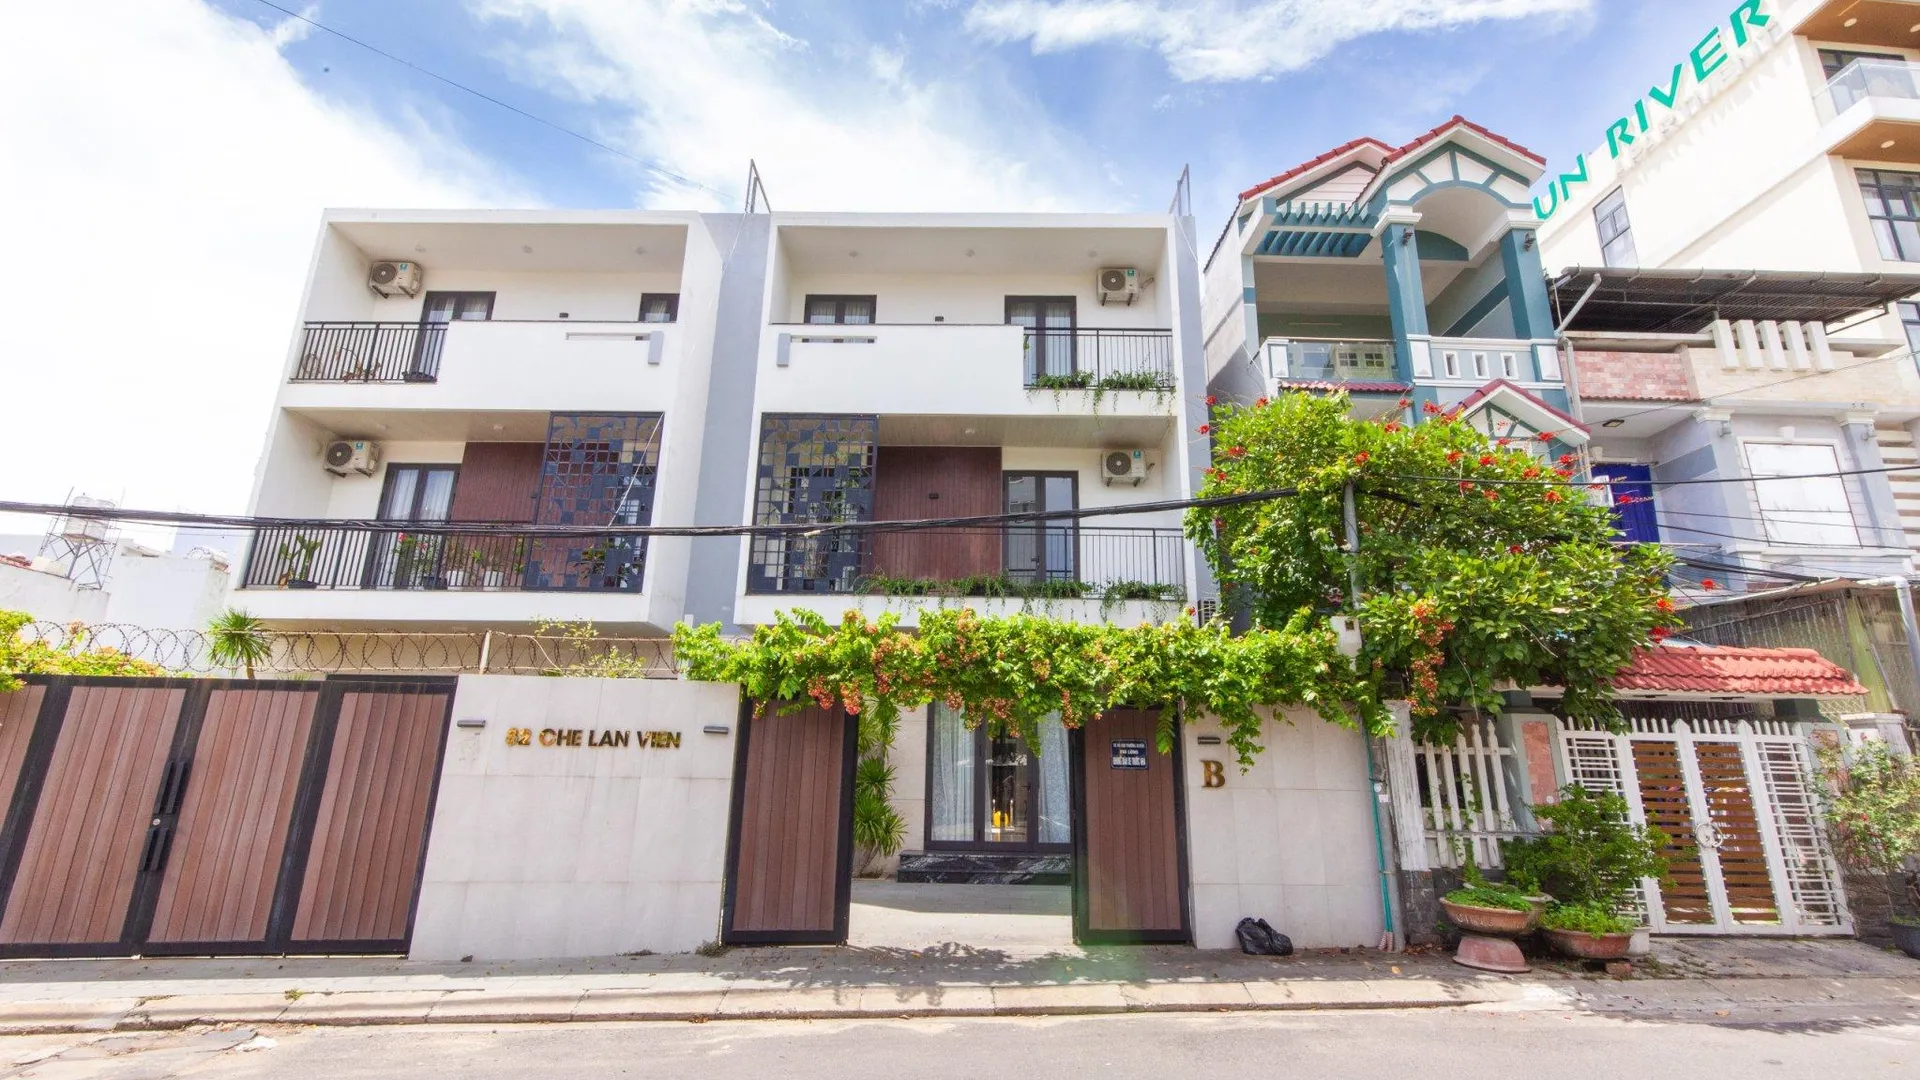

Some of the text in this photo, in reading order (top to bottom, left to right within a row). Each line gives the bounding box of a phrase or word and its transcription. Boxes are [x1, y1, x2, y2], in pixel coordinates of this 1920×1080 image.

[1605, 0, 1771, 159] RIVER
[538, 728, 583, 748] CHE
[588, 730, 630, 748] LAN
[637, 731, 682, 749] VIEN
[1200, 760, 1226, 788] B
